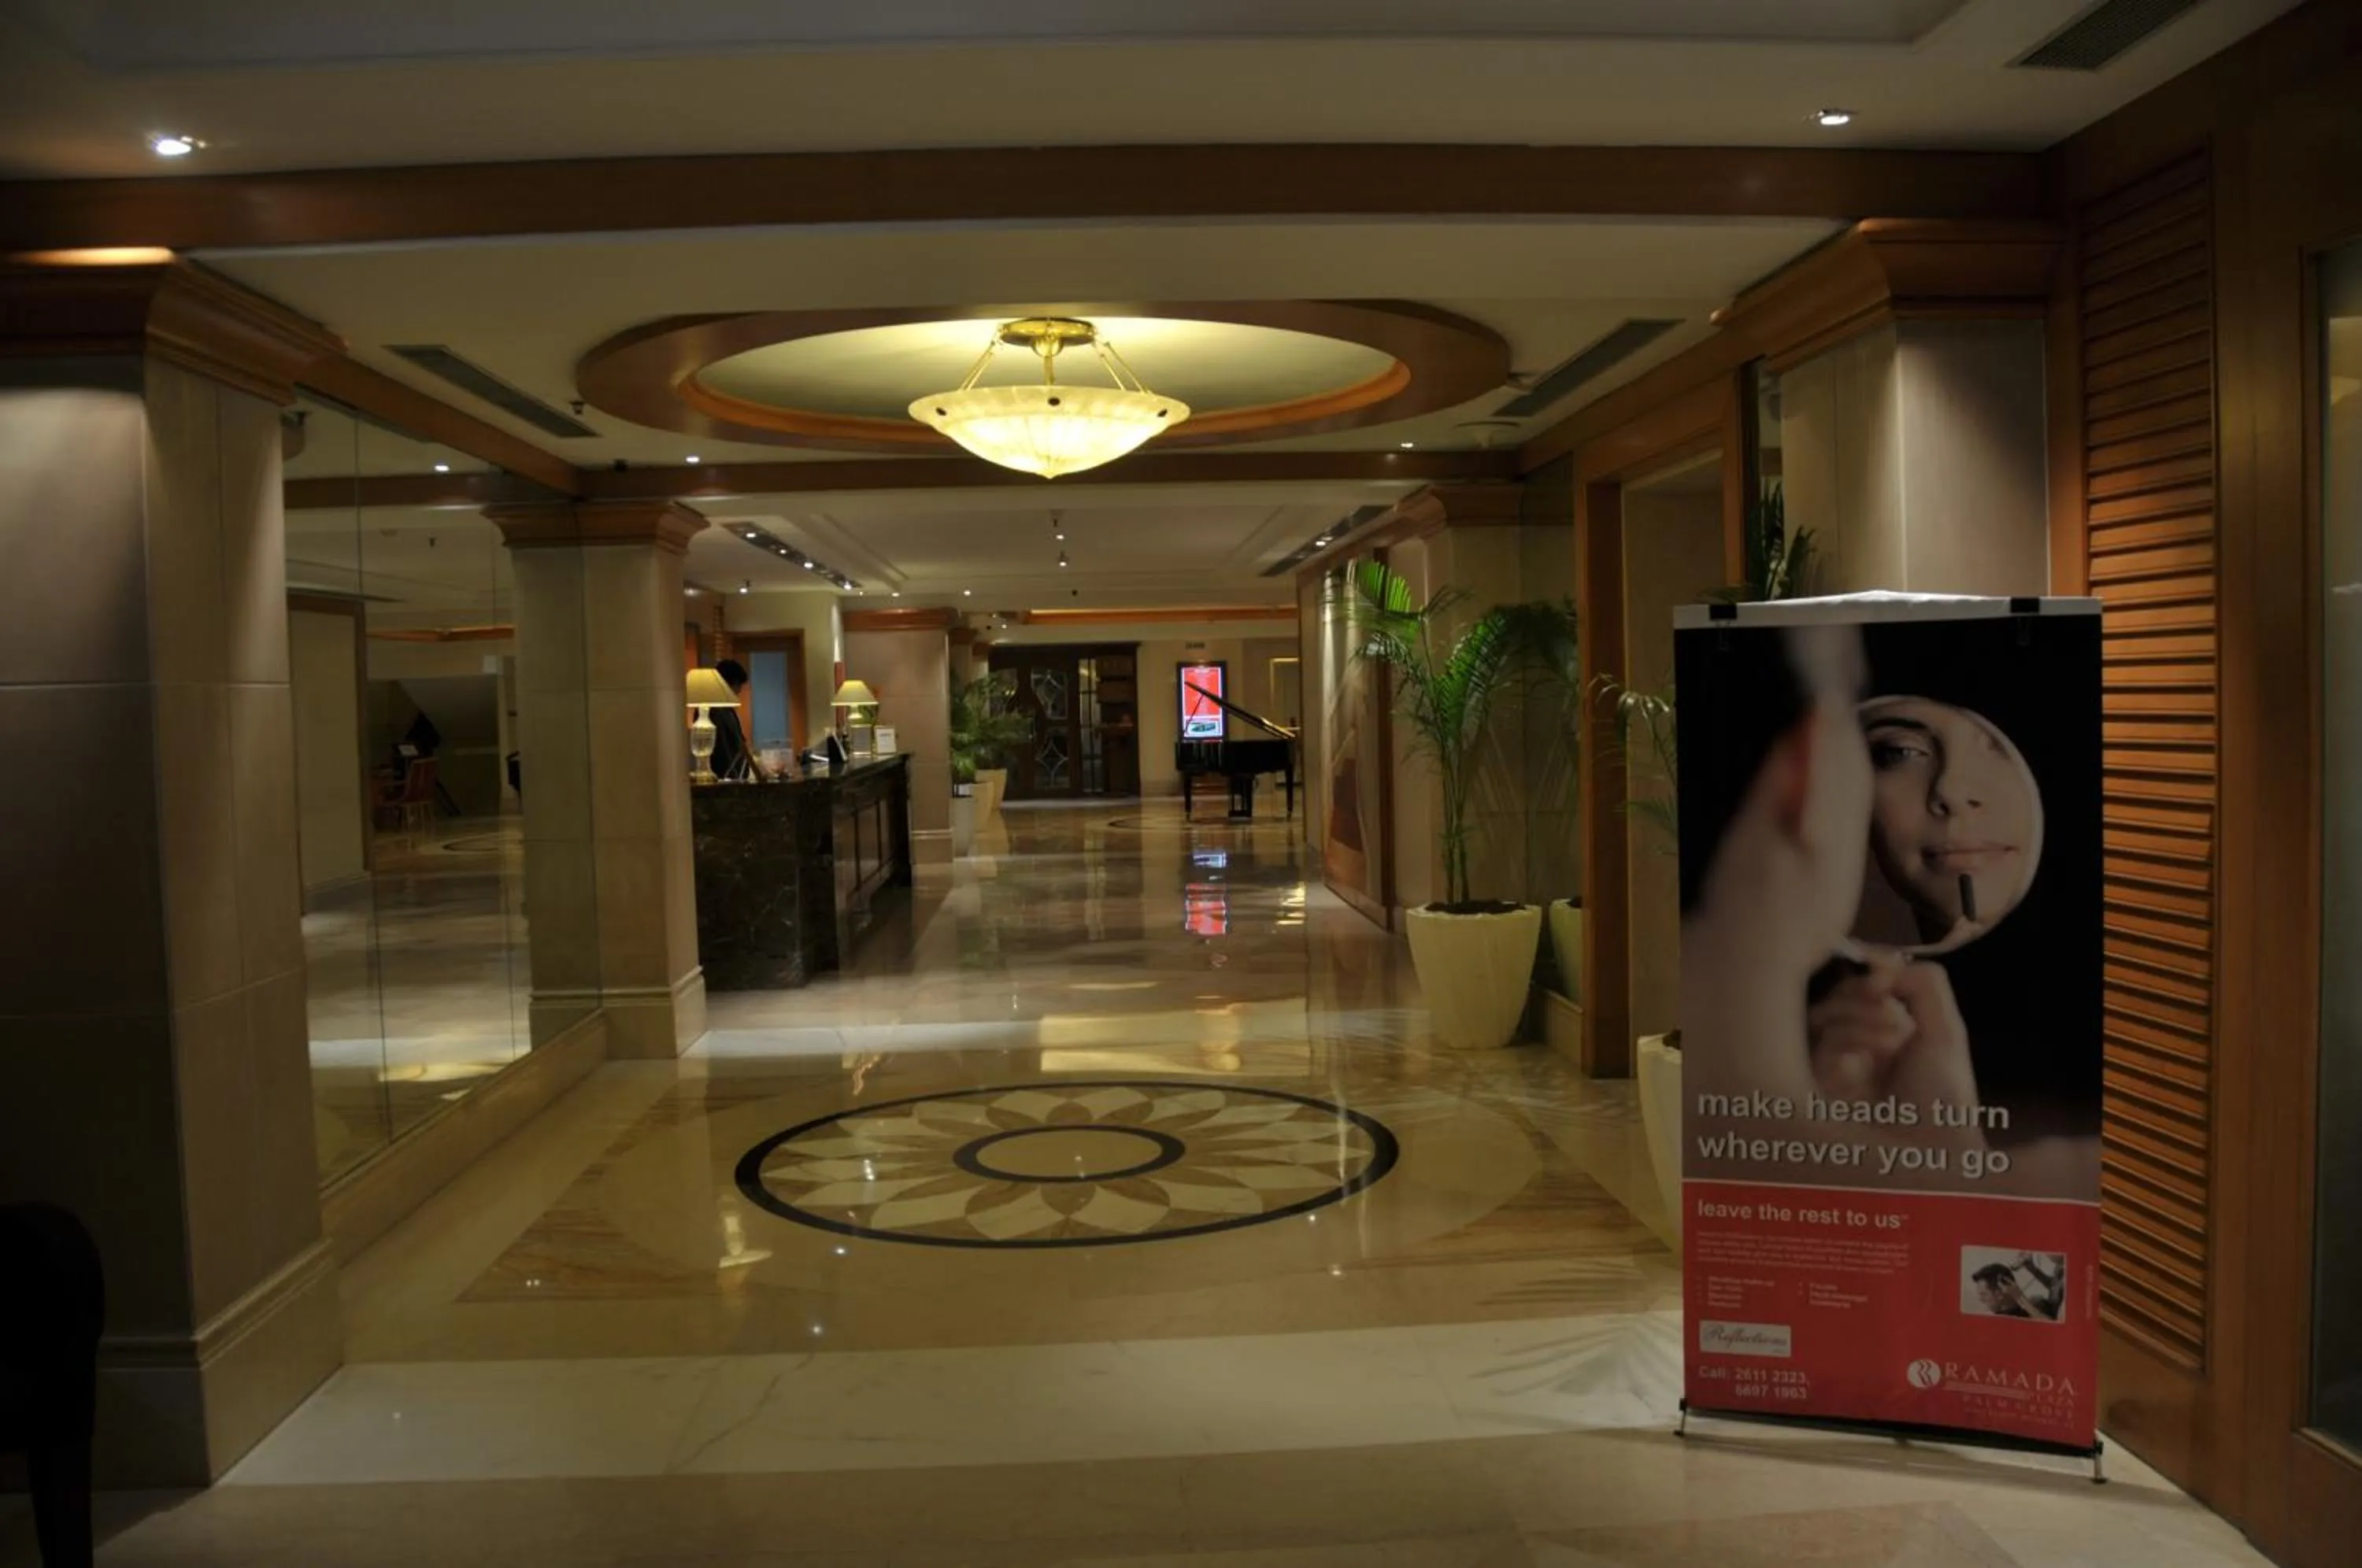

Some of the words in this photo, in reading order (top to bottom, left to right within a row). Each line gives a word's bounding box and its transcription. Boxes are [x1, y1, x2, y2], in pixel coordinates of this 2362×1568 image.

[1697, 1091, 1794, 1119] make
[1807, 1092, 1919, 1126] heads
[1932, 1099, 2010, 1130] turn
[1697, 1132, 1866, 1166] wherever
[1878, 1145, 1948, 1174] you
[1961, 1148, 2011, 1178] go
[1697, 1200, 1752, 1221] leave
[1758, 1204, 1791, 1222] the
[1798, 1207, 1840, 1225] rest
[1846, 1209, 1867, 1226] to
[1945, 1361, 2074, 1396] RAMADA
